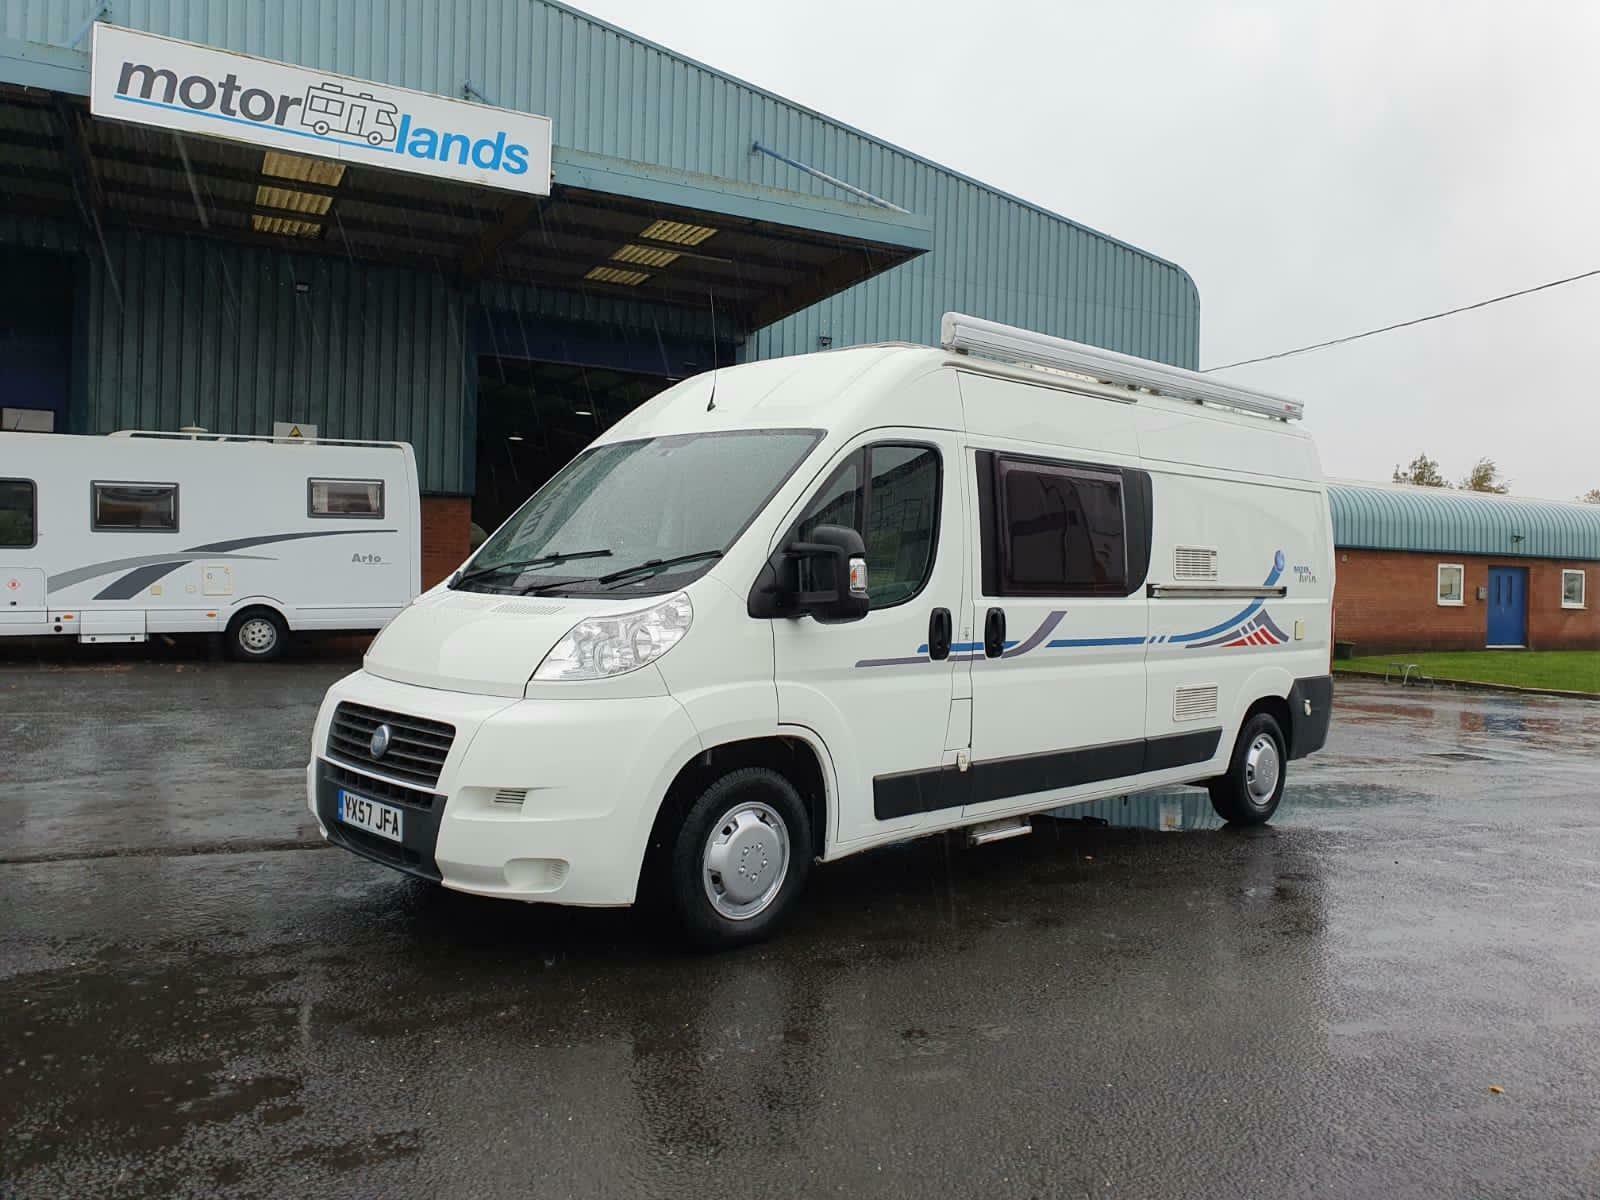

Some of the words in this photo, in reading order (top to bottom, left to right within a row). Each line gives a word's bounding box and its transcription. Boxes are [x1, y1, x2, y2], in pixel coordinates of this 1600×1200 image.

[117, 61, 302, 126] motor
[395, 114, 529, 175] lands
[351, 552, 382, 563] Arto
[344, 795, 373, 826] YX57
[375, 807, 399, 836] JFA
